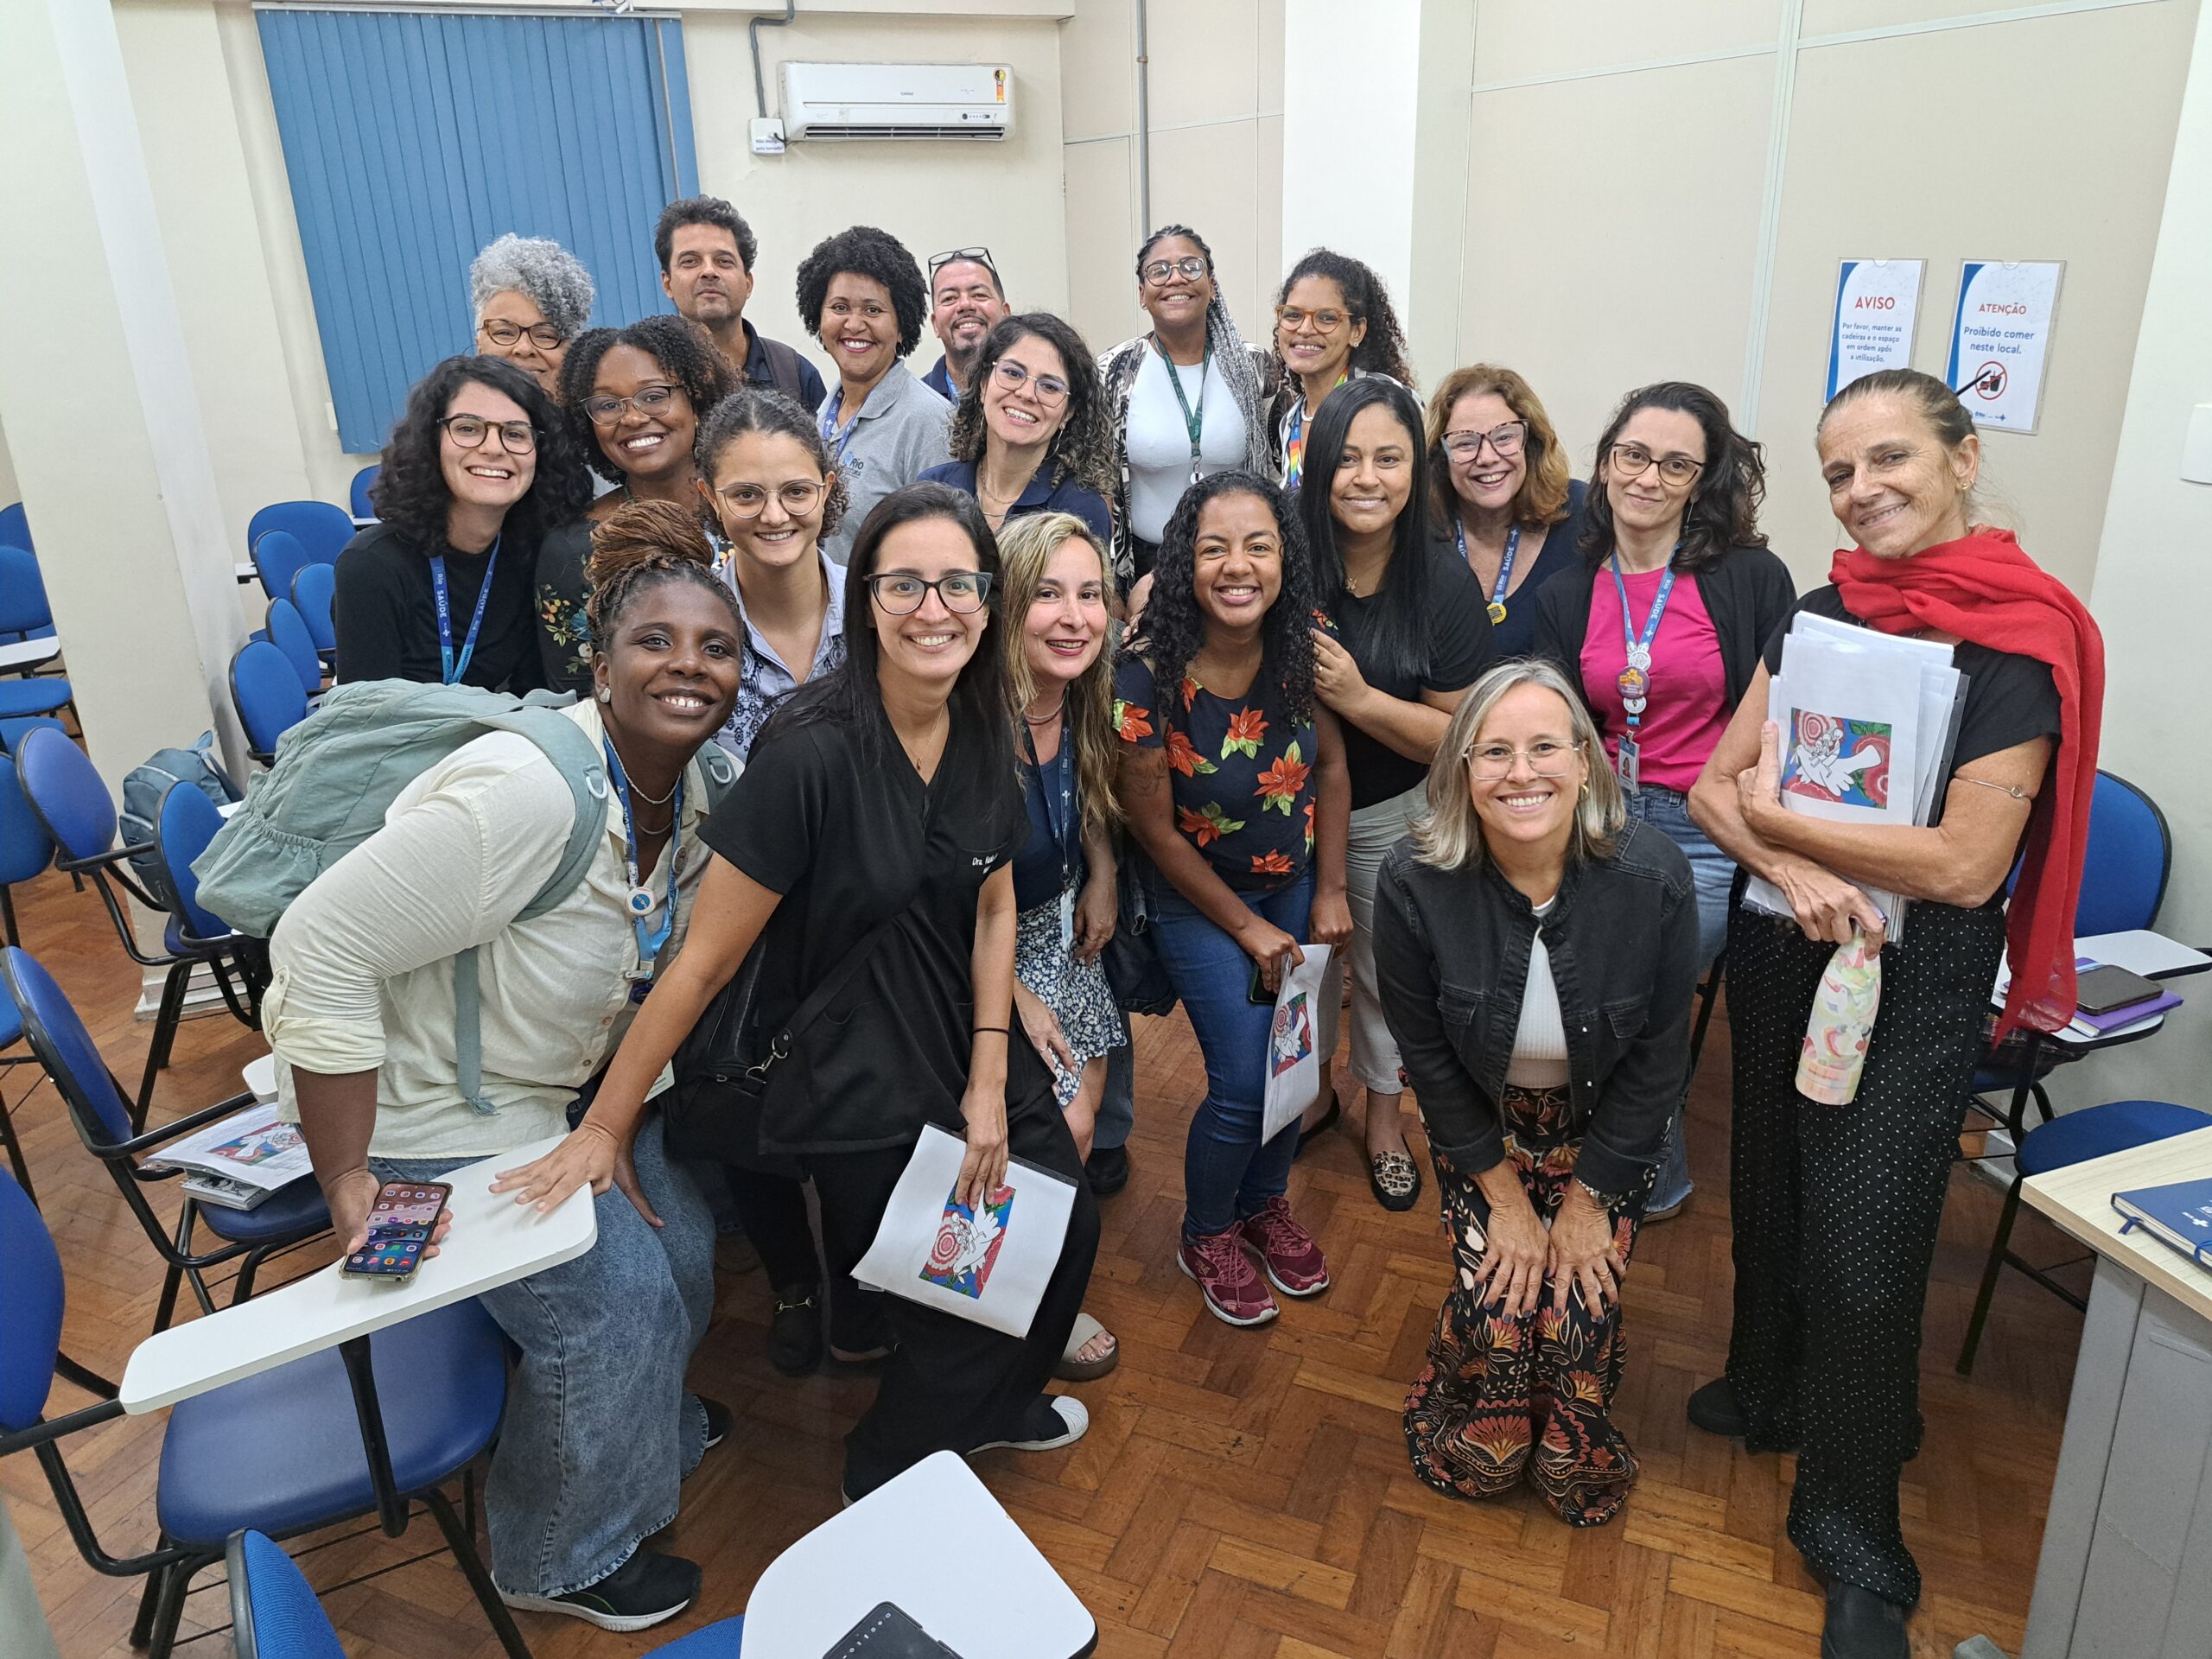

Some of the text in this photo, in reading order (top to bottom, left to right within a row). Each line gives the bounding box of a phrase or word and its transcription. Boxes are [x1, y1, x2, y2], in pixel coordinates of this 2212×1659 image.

[1854, 296, 1896, 310] AVISO
[1978, 302, 2027, 316] ATENÇÃO
[1853, 322, 1871, 332] favor,
[1963, 326, 2035, 340] Proibido comer
[1878, 335, 1900, 344] espaço
[1856, 343, 1877, 352] ordem
[1877, 345, 1892, 353] após
[1969, 342, 2022, 354] neste local.
[1855, 353, 1885, 363] utilização.
[849, 458, 864, 470] Rio
[1503, 546, 1515, 571] SAÚDE
[436, 589, 448, 619] SAÚDE
[478, 588, 490, 615] SAÚDE
[1650, 594, 1665, 620] SAÚDE
